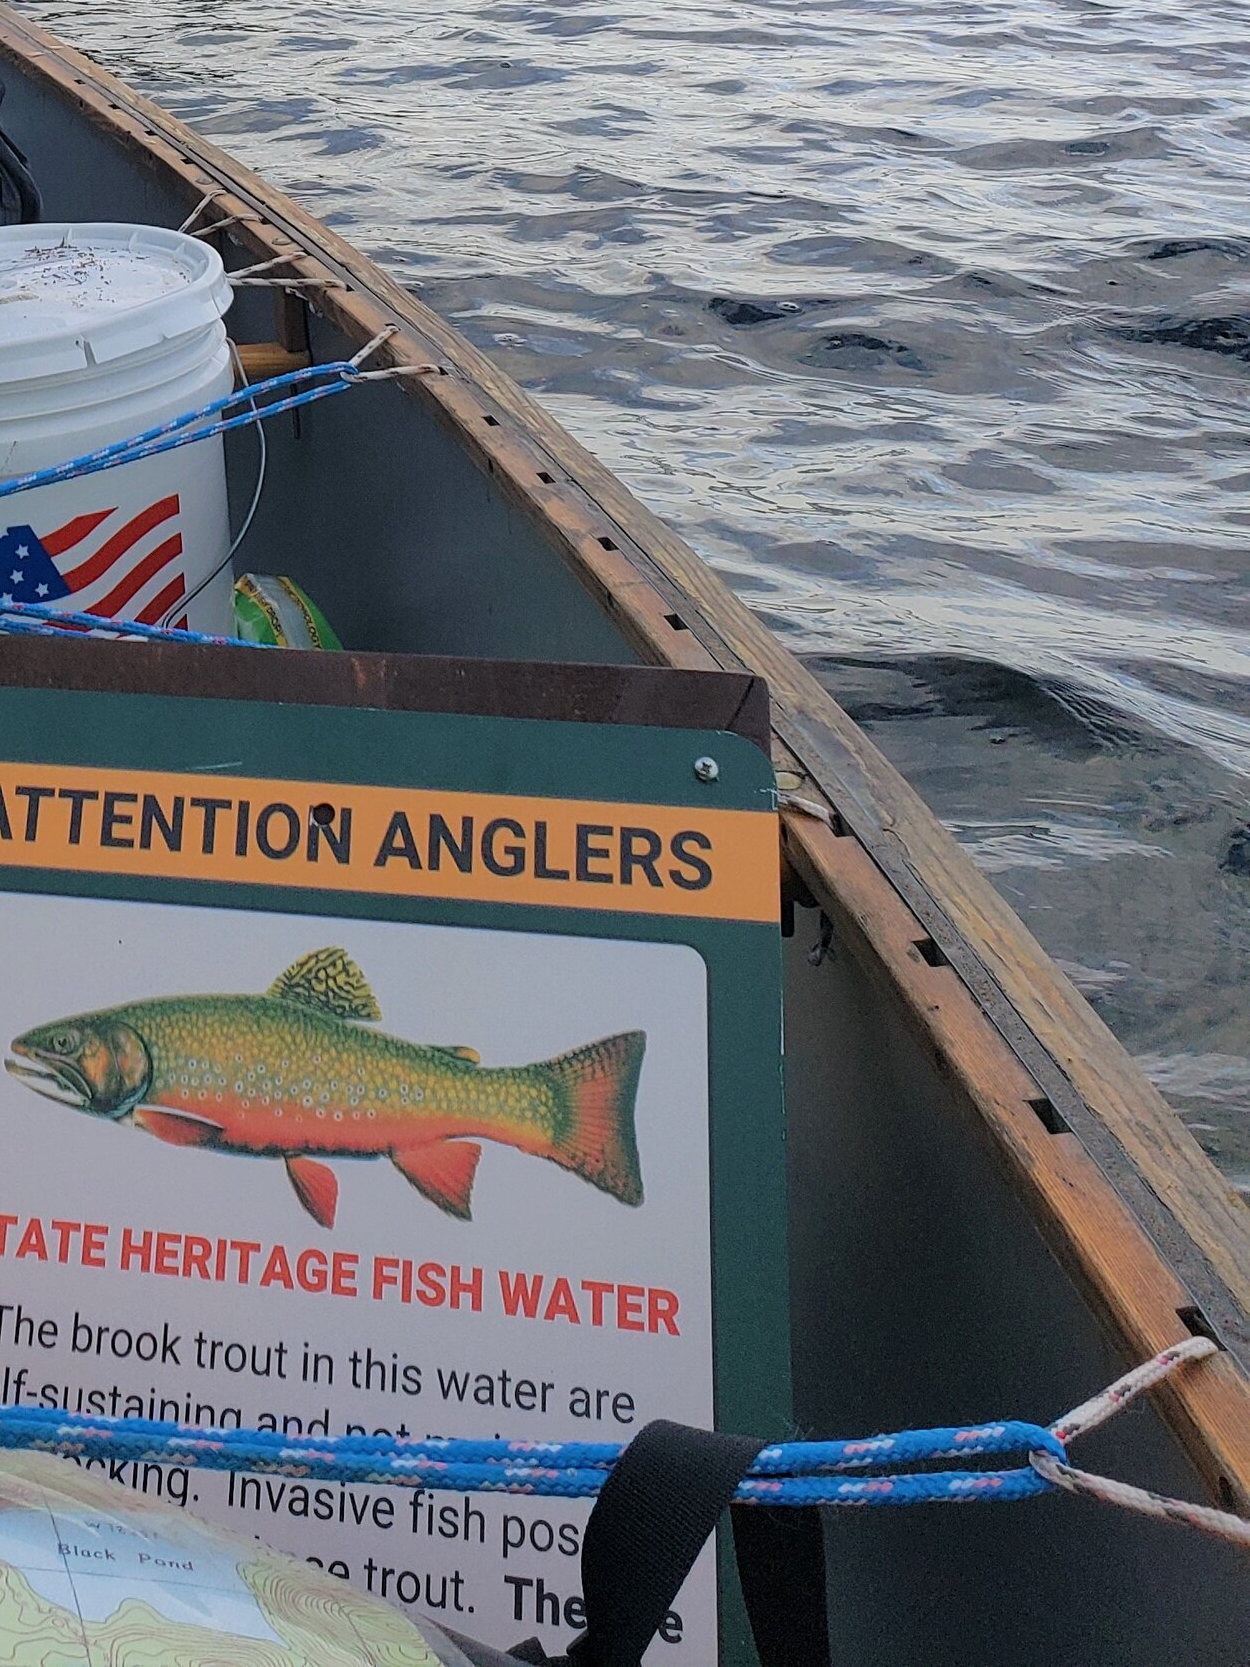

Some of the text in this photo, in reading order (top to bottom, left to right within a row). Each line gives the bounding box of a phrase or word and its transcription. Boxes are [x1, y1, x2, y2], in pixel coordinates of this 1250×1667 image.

[373, 810, 714, 892] ANGLERS
[120, 1227, 359, 1298] HERITAGE
[371, 1255, 484, 1312] FISH
[498, 1270, 681, 1337] WATER
[71, 1311, 182, 1366] brook
[193, 1330, 288, 1380] trout
[301, 1341, 335, 1385] in
[349, 1347, 423, 1396] this
[437, 1368, 555, 1413] water
[568, 1386, 636, 1424] are
[227, 1470, 395, 1530] Invasive
[409, 1489, 486, 1544] fish
[58, 1543, 194, 1571] Black Pond
[363, 1557, 475, 1613] trout.
